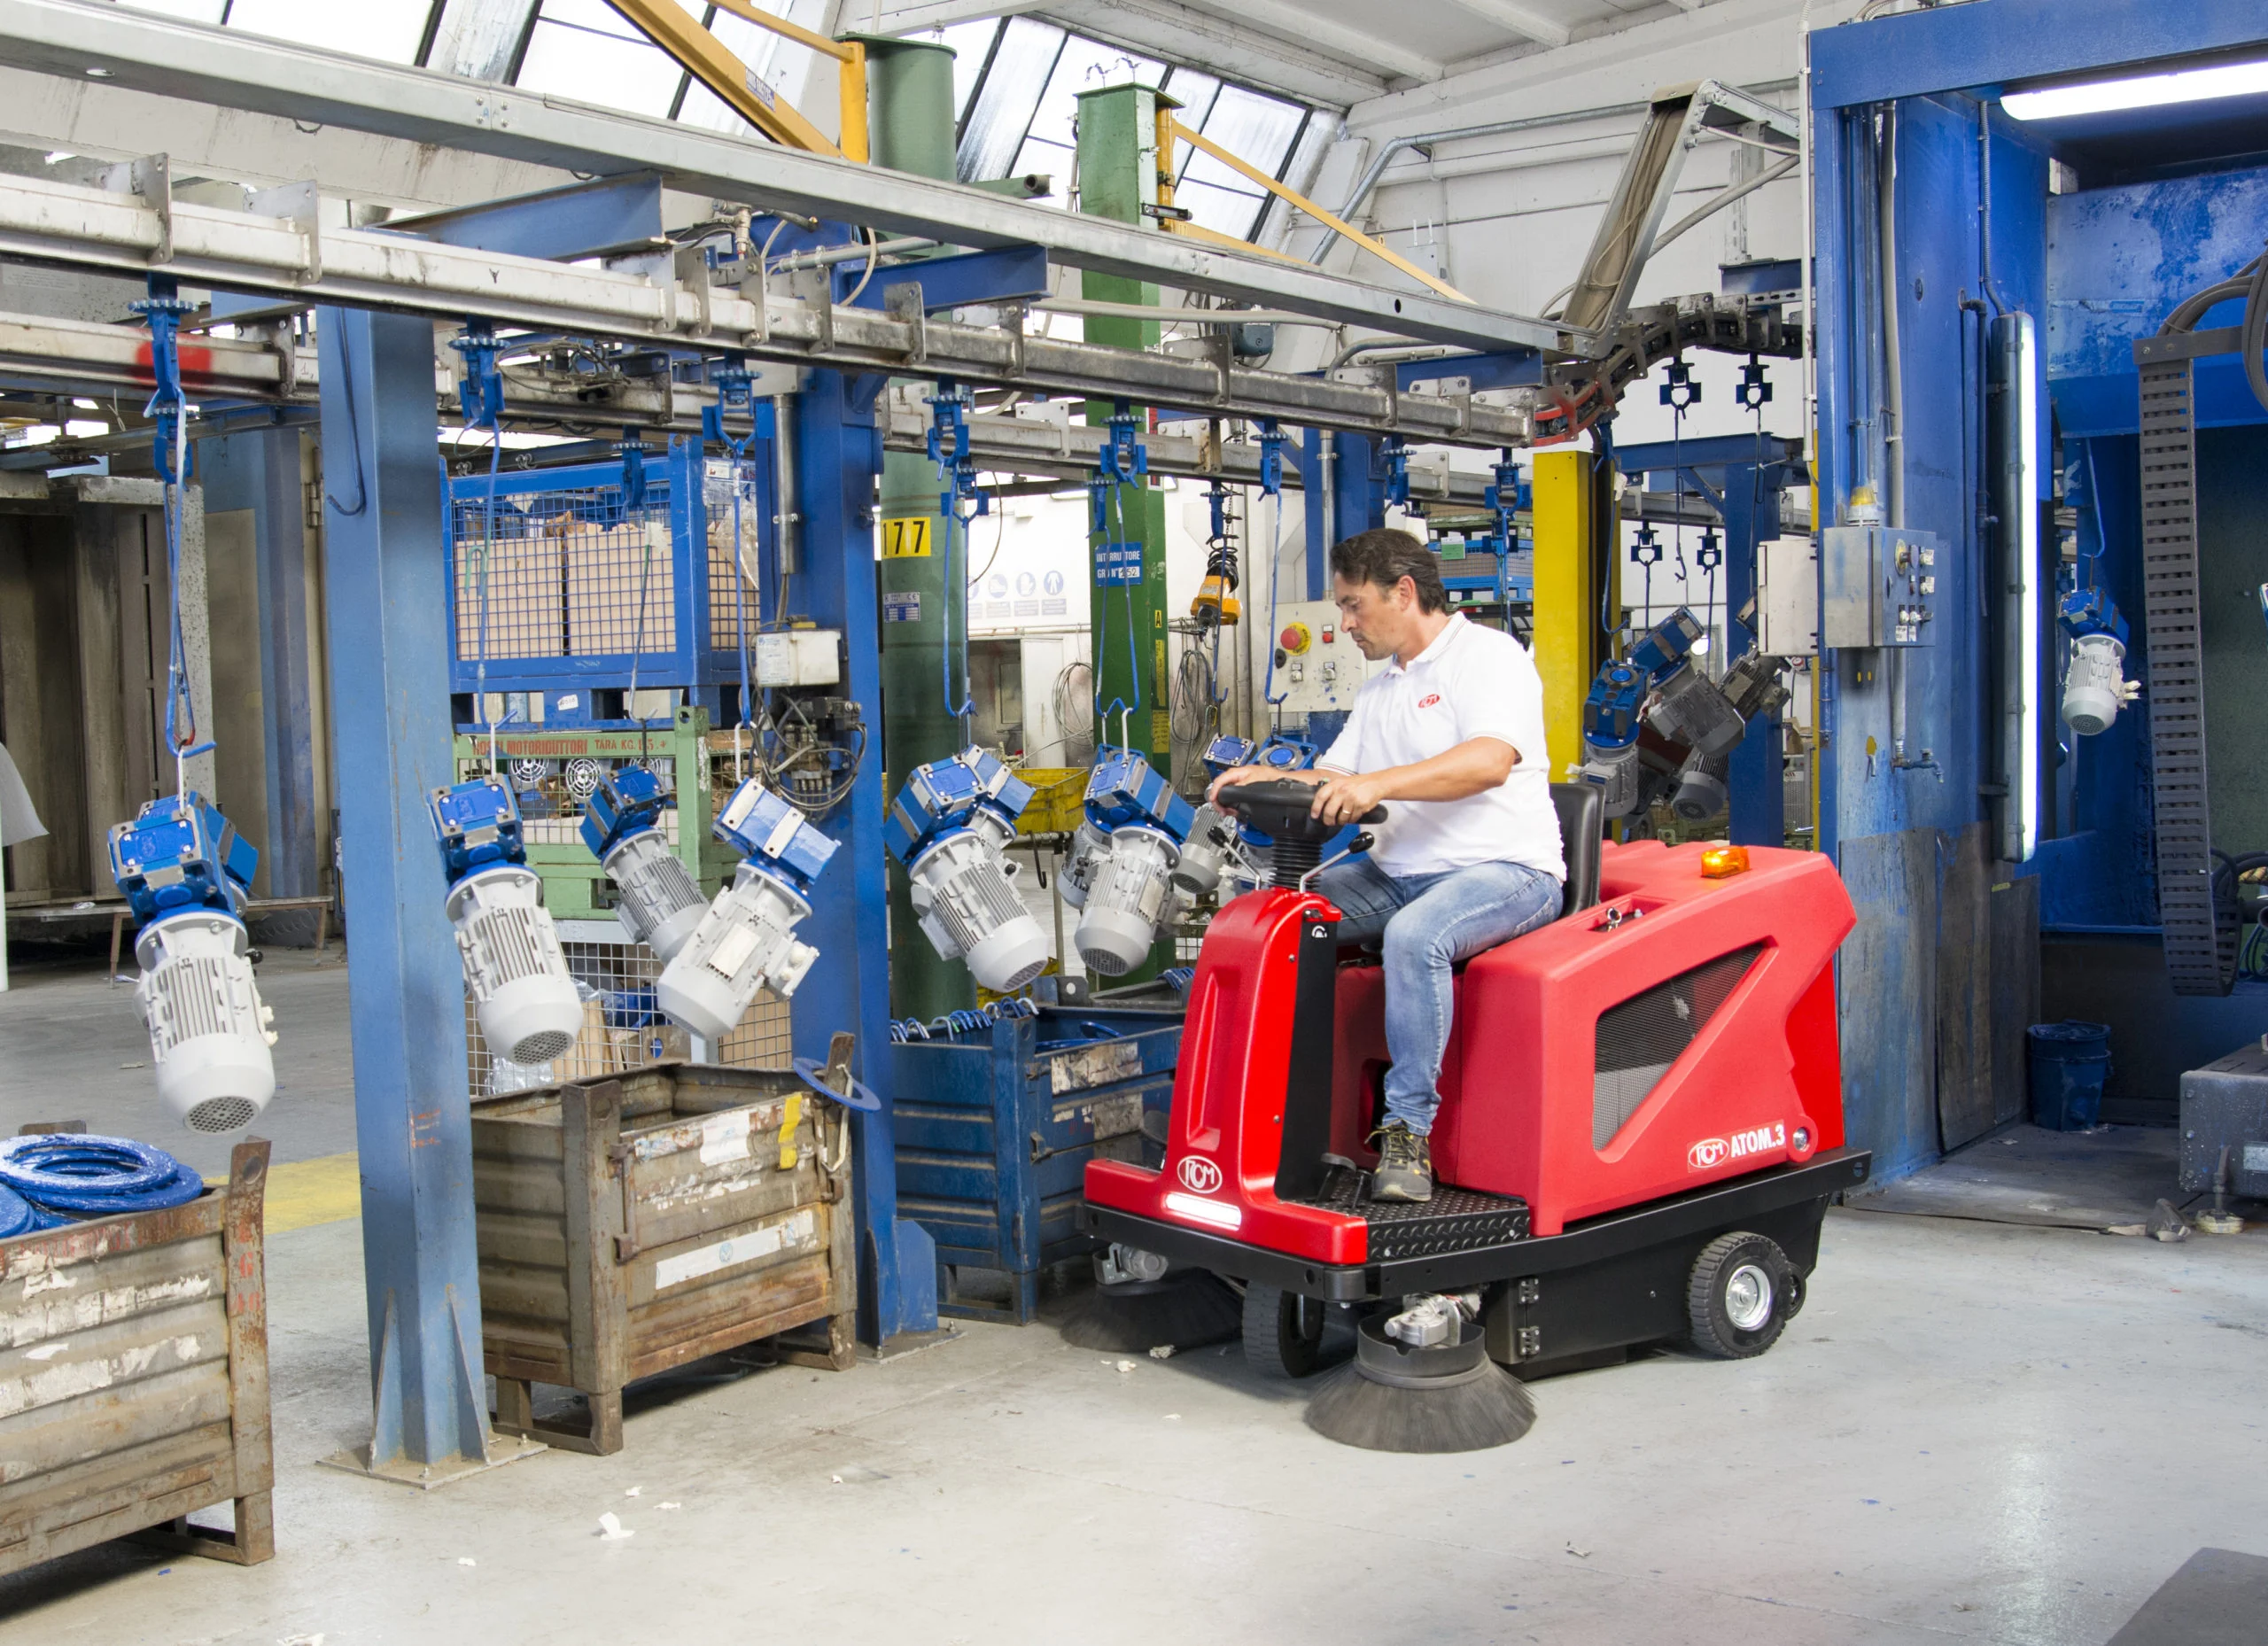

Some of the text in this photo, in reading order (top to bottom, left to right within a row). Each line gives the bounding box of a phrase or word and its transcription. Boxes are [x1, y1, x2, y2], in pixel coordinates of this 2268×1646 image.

[883, 520, 926, 555] 177
[1096, 550, 1141, 563] INTRRUTORE
[1155, 610, 1162, 627] A
[507, 738, 588, 756] MOTORIDUTTORI
[594, 738, 617, 750] TARA
[1730, 1123, 1787, 1159] ATOM.3
